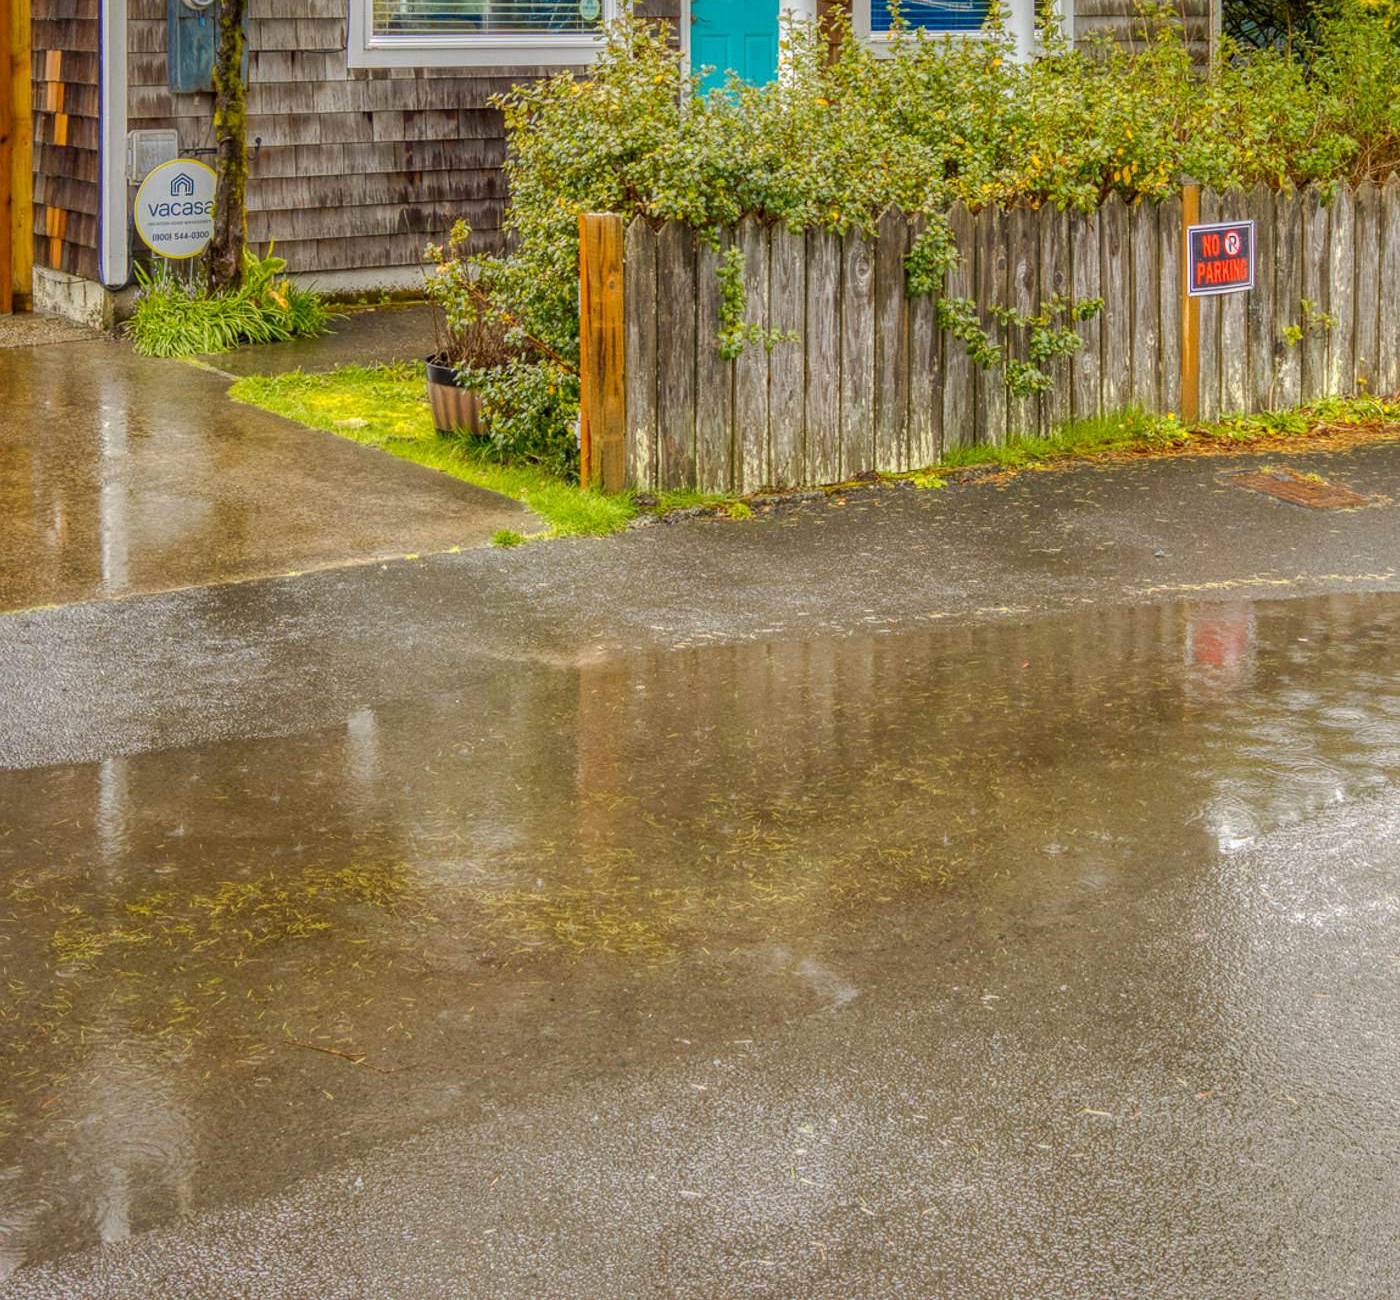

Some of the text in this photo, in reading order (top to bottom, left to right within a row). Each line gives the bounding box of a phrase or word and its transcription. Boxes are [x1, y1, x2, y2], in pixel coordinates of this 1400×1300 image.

[147, 200, 214, 217] vacasa
[174, 230, 210, 241] 544-0300
[1201, 232, 1221, 258] NO
[1196, 257, 1248, 285] PARKING
